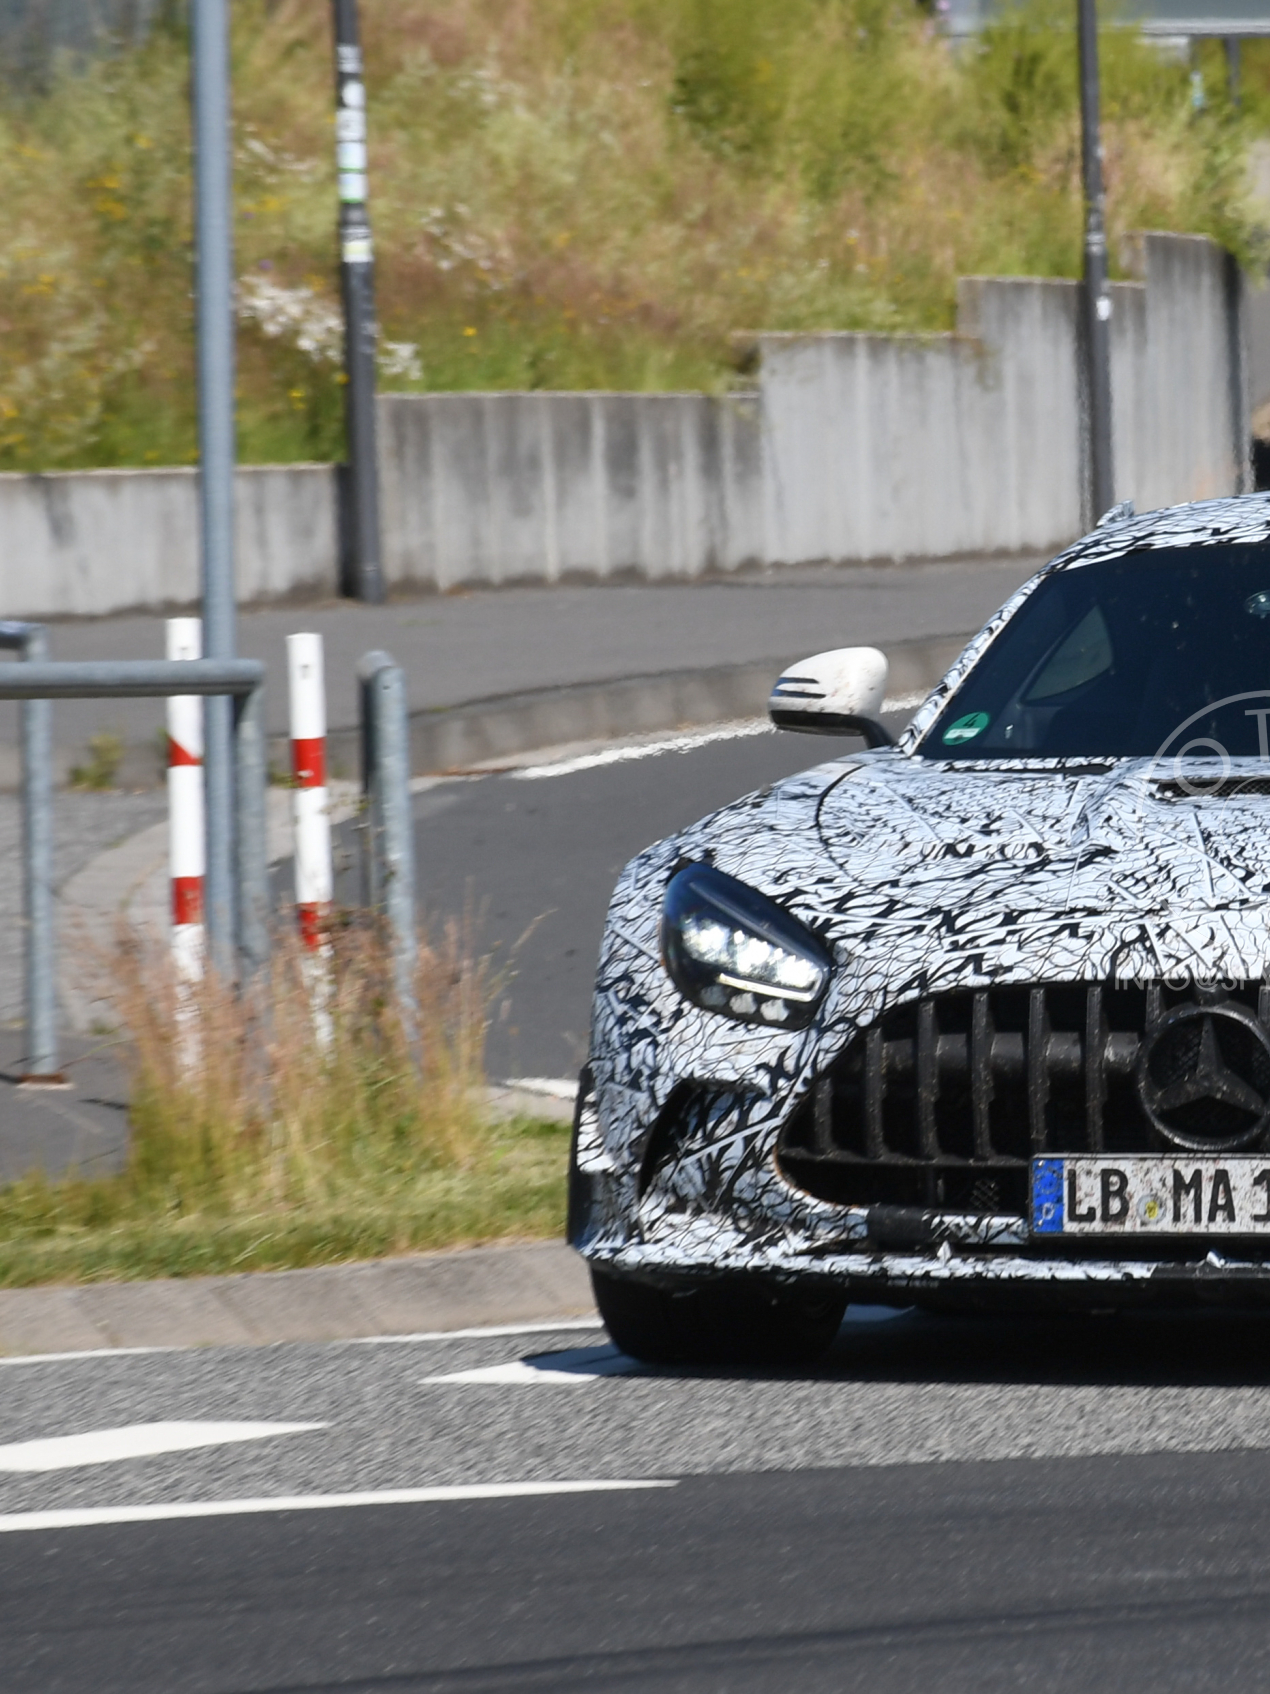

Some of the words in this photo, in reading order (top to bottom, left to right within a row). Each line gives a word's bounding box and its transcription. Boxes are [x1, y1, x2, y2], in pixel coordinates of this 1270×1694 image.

[962, 712, 981, 728] 4
[1066, 1168, 1130, 1223] LB
[1172, 1168, 1237, 1223] MA
